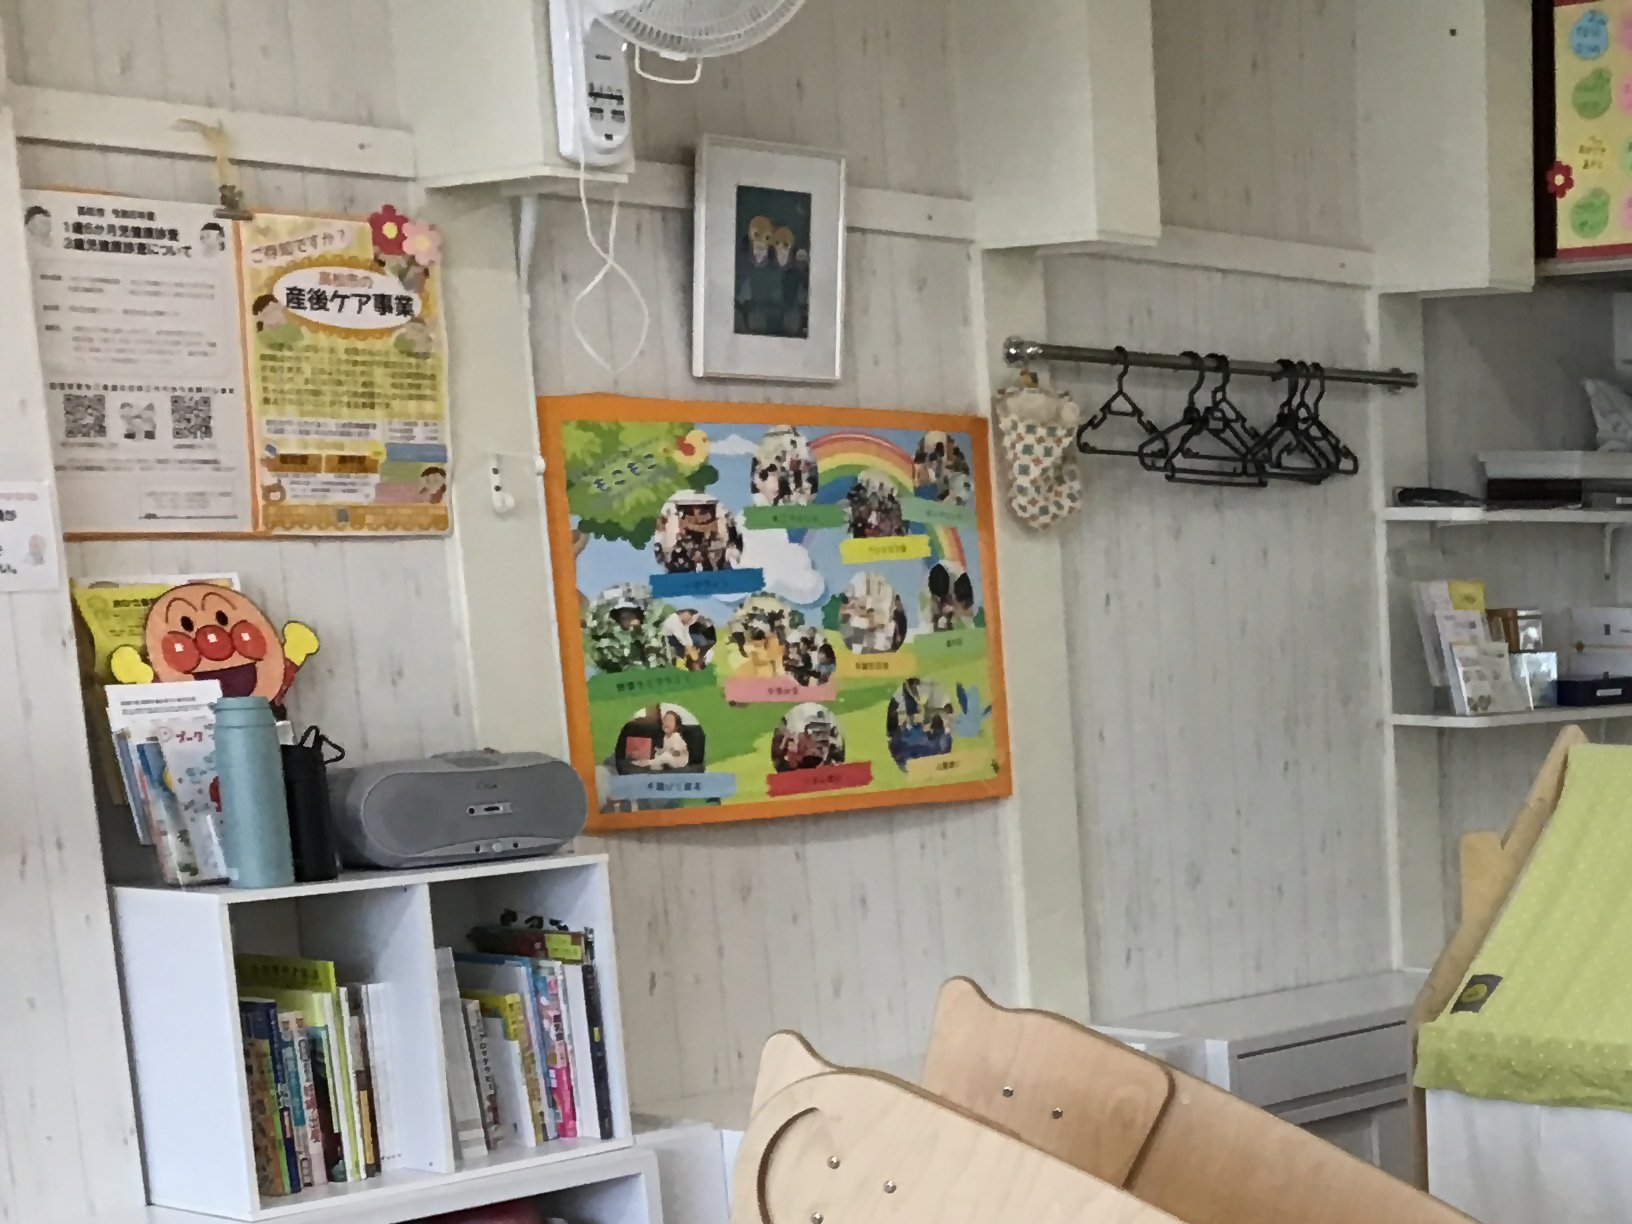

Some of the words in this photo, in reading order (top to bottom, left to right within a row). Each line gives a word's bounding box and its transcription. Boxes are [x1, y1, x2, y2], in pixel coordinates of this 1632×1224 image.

[285, 286, 415, 318] 産後ケア事業
